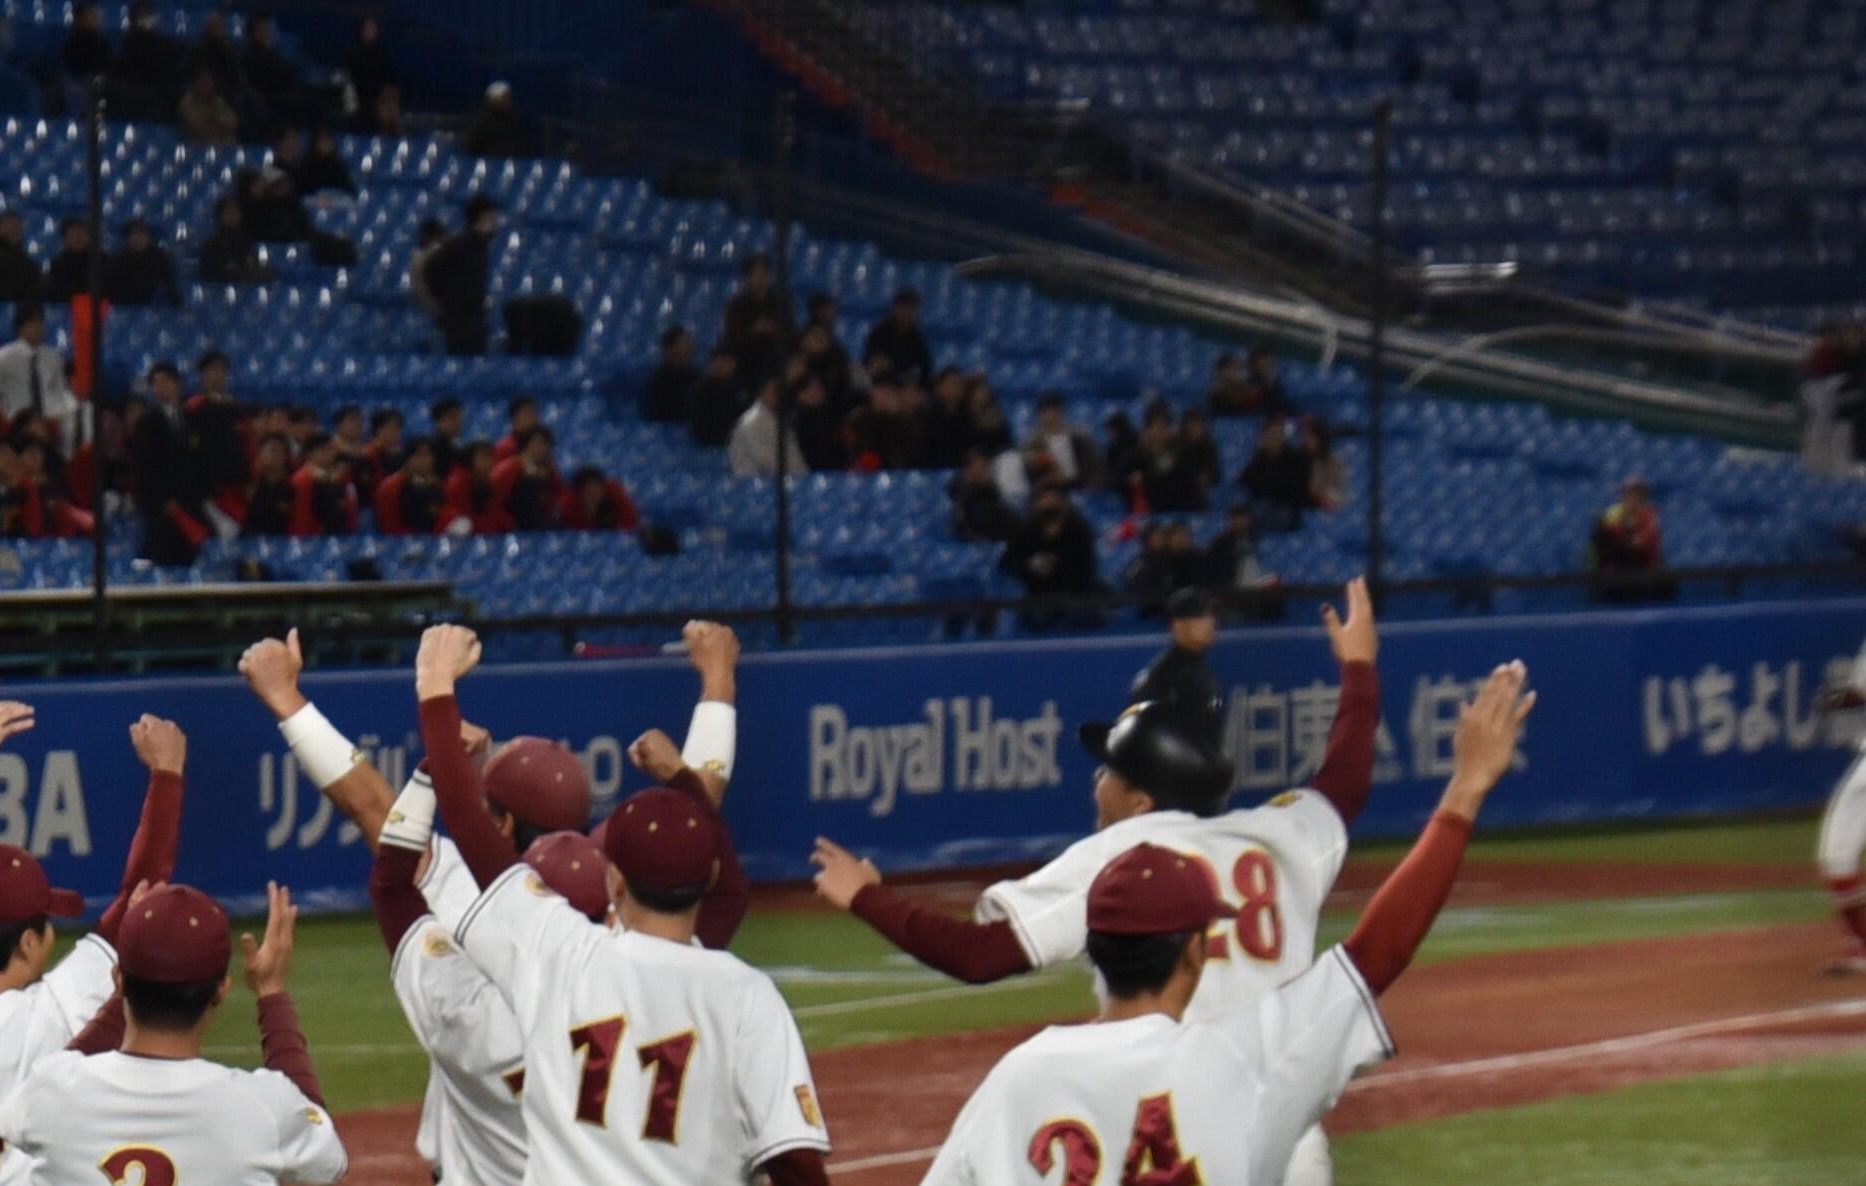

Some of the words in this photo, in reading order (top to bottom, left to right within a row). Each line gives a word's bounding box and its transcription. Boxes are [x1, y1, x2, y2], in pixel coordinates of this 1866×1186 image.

[809, 697, 946, 817] Royal
[949, 696, 1063, 790] Host
[568, 1012, 700, 1148] 11
